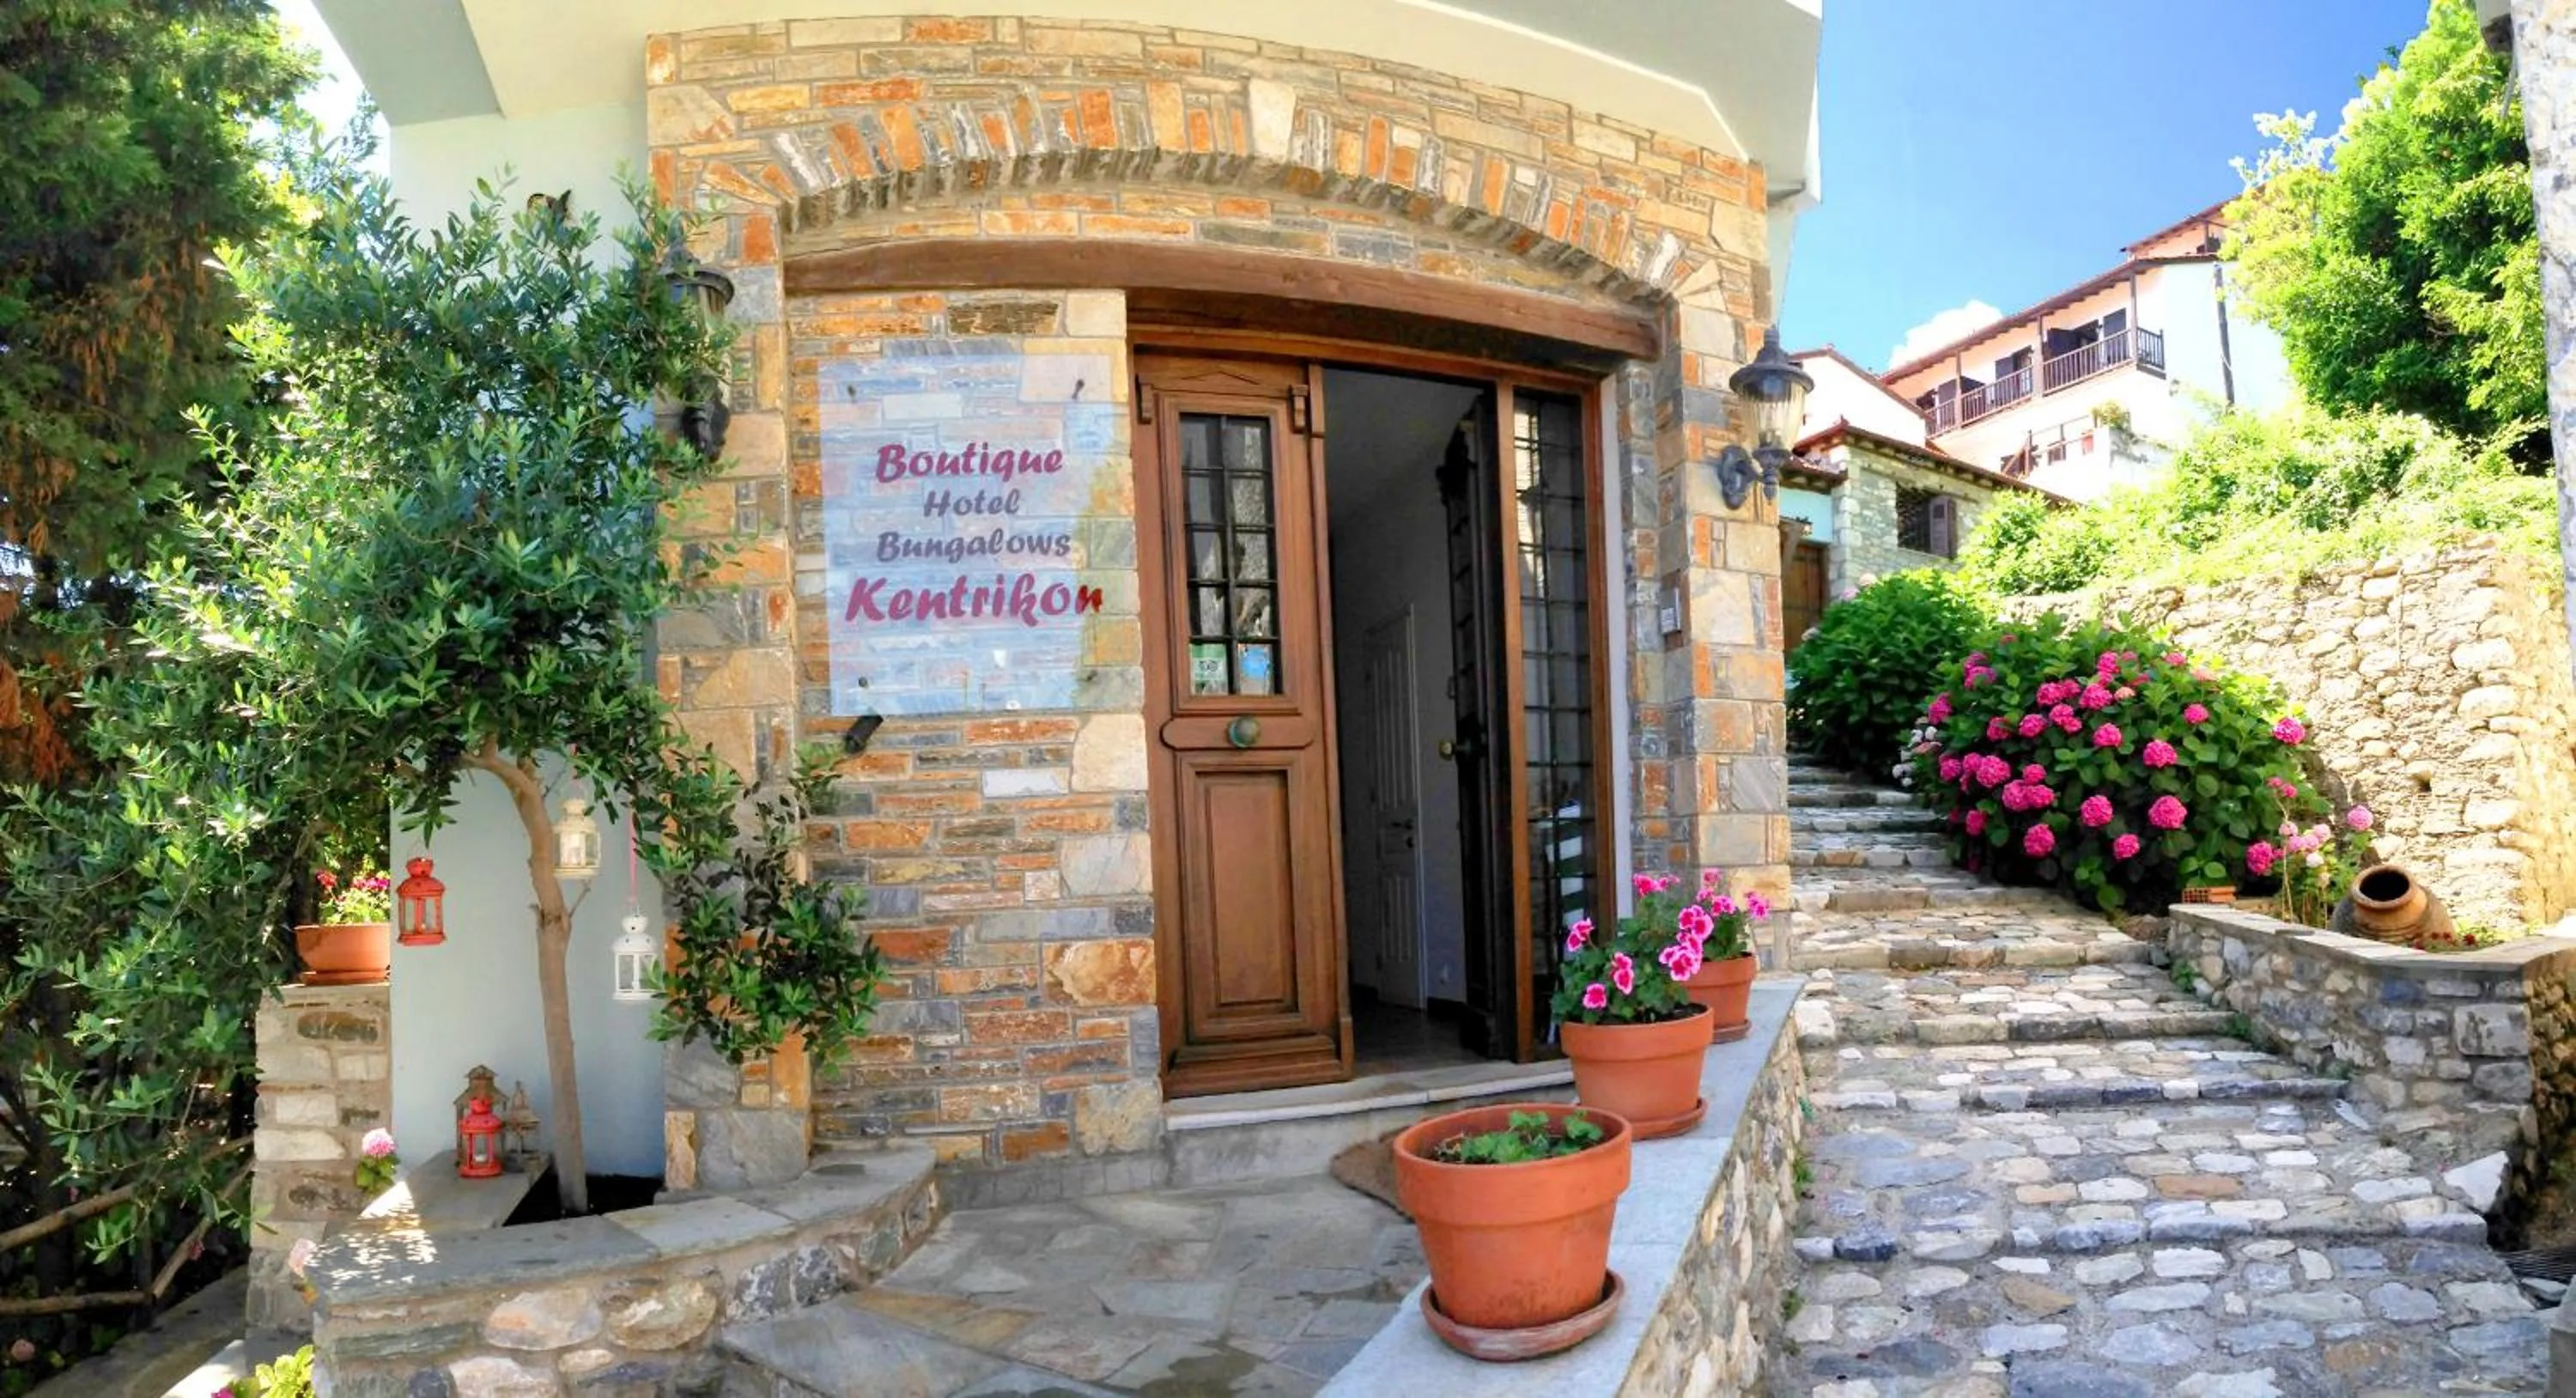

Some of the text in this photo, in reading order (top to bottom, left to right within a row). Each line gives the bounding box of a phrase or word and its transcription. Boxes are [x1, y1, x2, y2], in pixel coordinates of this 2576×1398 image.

[876, 442, 1063, 483] Boutique
[924, 489, 1020, 517] Hotel
[877, 528, 1071, 563] Bungalows
[845, 574, 1103, 626] Kentrikon
